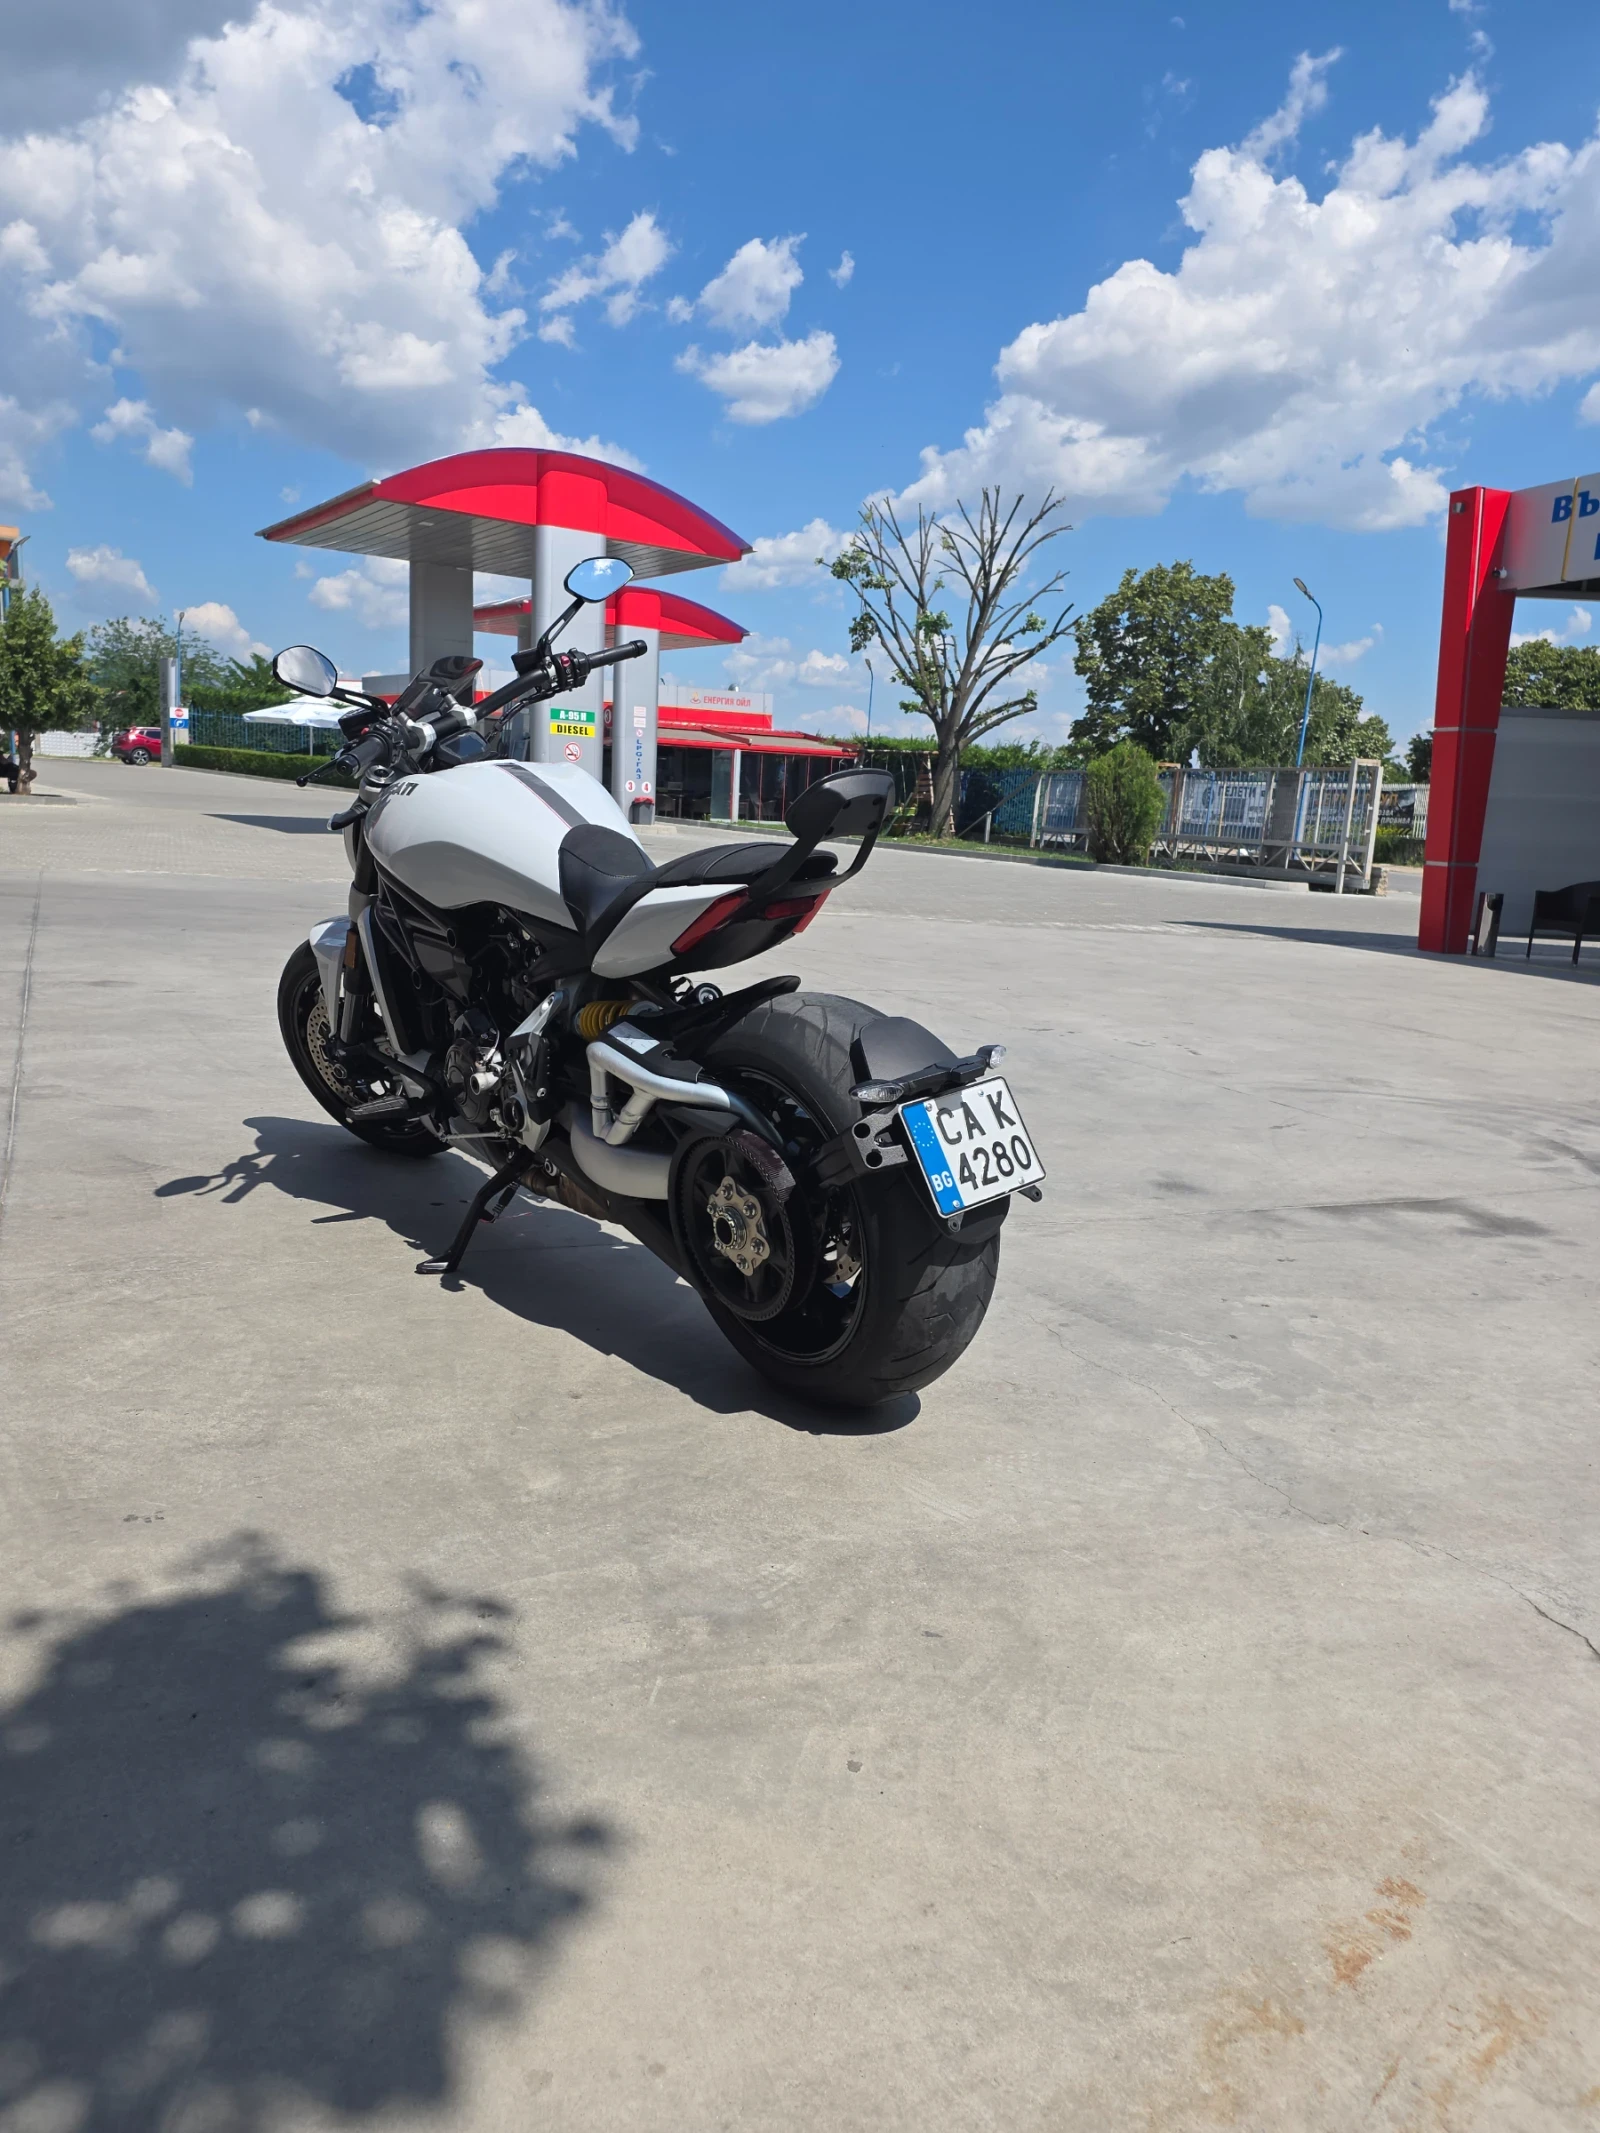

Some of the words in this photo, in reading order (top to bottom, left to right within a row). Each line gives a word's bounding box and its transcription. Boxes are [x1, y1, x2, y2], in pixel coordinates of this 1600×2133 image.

[703, 695, 734, 706] ЕНЕРГИЯ
[735, 697, 751, 707] ОЙЛ
[556, 724, 589, 736] DIESEL
[627, 781, 633, 791] 3
[643, 783, 649, 792] 4
[936, 1101, 986, 1145] CA
[986, 1090, 1017, 1130] K
[959, 1134, 1032, 1191] 4280
[930, 1170, 953, 1192] BG
